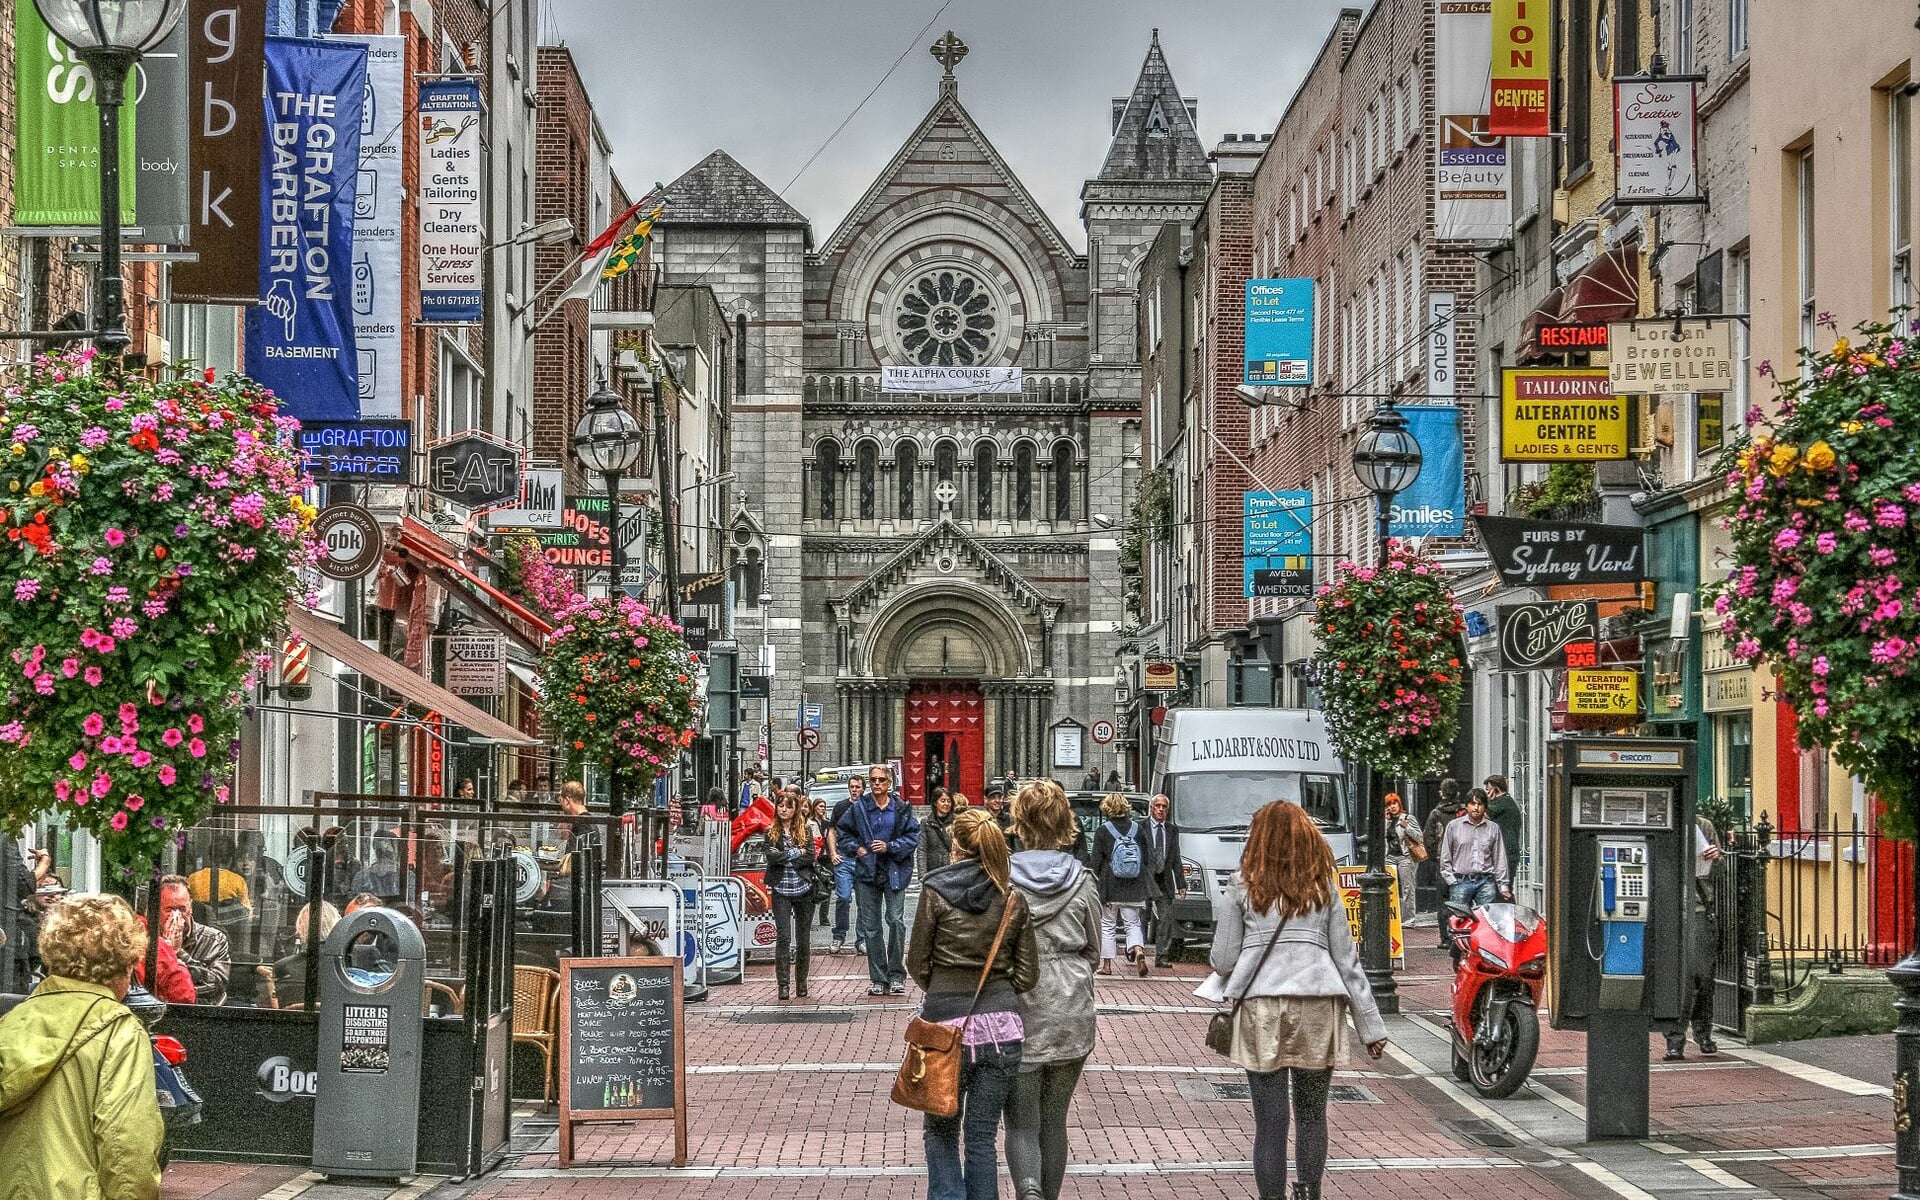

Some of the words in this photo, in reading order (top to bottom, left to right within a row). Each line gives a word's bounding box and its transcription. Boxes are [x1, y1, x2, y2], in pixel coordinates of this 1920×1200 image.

[1446, 3, 1491, 13] 671644
[1494, 89, 1545, 107] CENTRE
[1637, 83, 1675, 105] Sew
[275, 92, 337, 119] THE
[421, 101, 478, 109] ALTERATIONS
[1626, 103, 1682, 121] Creative
[47, 146, 99, 155] DENTA
[360, 144, 397, 154] enders
[430, 148, 470, 159] Ladies
[59, 159, 98, 168] SPAS
[1440, 151, 1505, 165] Essence
[141, 157, 179, 174] body
[445, 161, 455, 172] &
[432, 174, 469, 185] Gents
[1438, 170, 1503, 185] Beauty
[270, 122, 300, 274] BARBER
[423, 187, 478, 201] Tailoring
[303, 123, 337, 301] GRAFTON
[440, 209, 462, 222] Dry
[353, 227, 395, 237] menders
[423, 222, 478, 233] Cleaners
[422, 244, 447, 255] One
[450, 244, 480, 255] Hour
[427, 256, 474, 271] Xpress
[427, 272, 475, 283] Services
[1250, 285, 1284, 295] Offices
[423, 296, 435, 305] Ph:
[436, 296, 446, 304] 01
[447, 296, 480, 305] 6717813
[1250, 296, 1262, 306] To
[1263, 296, 1280, 306] Let
[353, 323, 395, 334] menders
[1636, 327, 1705, 341] Loran
[1541, 327, 1607, 346] RESTAUR
[265, 346, 340, 359] BASEMENT
[1627, 345, 1716, 359] Brereton
[888, 369, 910, 378] THE
[911, 369, 946, 378] ALPHA
[948, 369, 991, 378] COURSE
[1611, 360, 1731, 381] JEWELLER
[1523, 379, 1610, 396] TAILORING
[1515, 405, 1620, 421] ALTERATIONS
[321, 428, 406, 448] GRAFTON
[1537, 424, 1597, 441] CENTRE
[1514, 444, 1557, 454] LADIES
[1563, 444, 1572, 454] &
[1576, 444, 1619, 454] GENTS
[435, 452, 513, 495] EAT
[576, 499, 610, 511] WINE
[1249, 498, 1277, 507] Prime
[1279, 497, 1306, 506] Retail
[318, 510, 348, 531] gourmet
[528, 511, 553, 523] CAFÉ
[1390, 504, 1454, 524] Smiles
[349, 511, 372, 532] burger
[1250, 521, 1261, 529] To
[1263, 520, 1278, 529] Let
[327, 530, 361, 552] gbk
[1522, 531, 1560, 543] FURS
[1566, 530, 1586, 542] BY
[544, 548, 612, 567] OUNGE
[1503, 545, 1582, 582] Sydney
[1586, 544, 1638, 573] Vard
[329, 562, 360, 572] kitchen
[1257, 584, 1310, 595] WHETSTONE
[1502, 603, 1588, 667] Cave
[1564, 642, 1596, 654] WINE
[1567, 654, 1596, 667] BAR
[1586, 683, 1620, 691] CENTRE
[1097, 726, 1109, 736] 50
[1296, 739, 1321, 762] LTD
[345, 1007, 376, 1018] LITTER
[377, 1007, 388, 1018] IS
[345, 1018, 387, 1027] DISGUSTING
[273, 1066, 317, 1095] Boc
